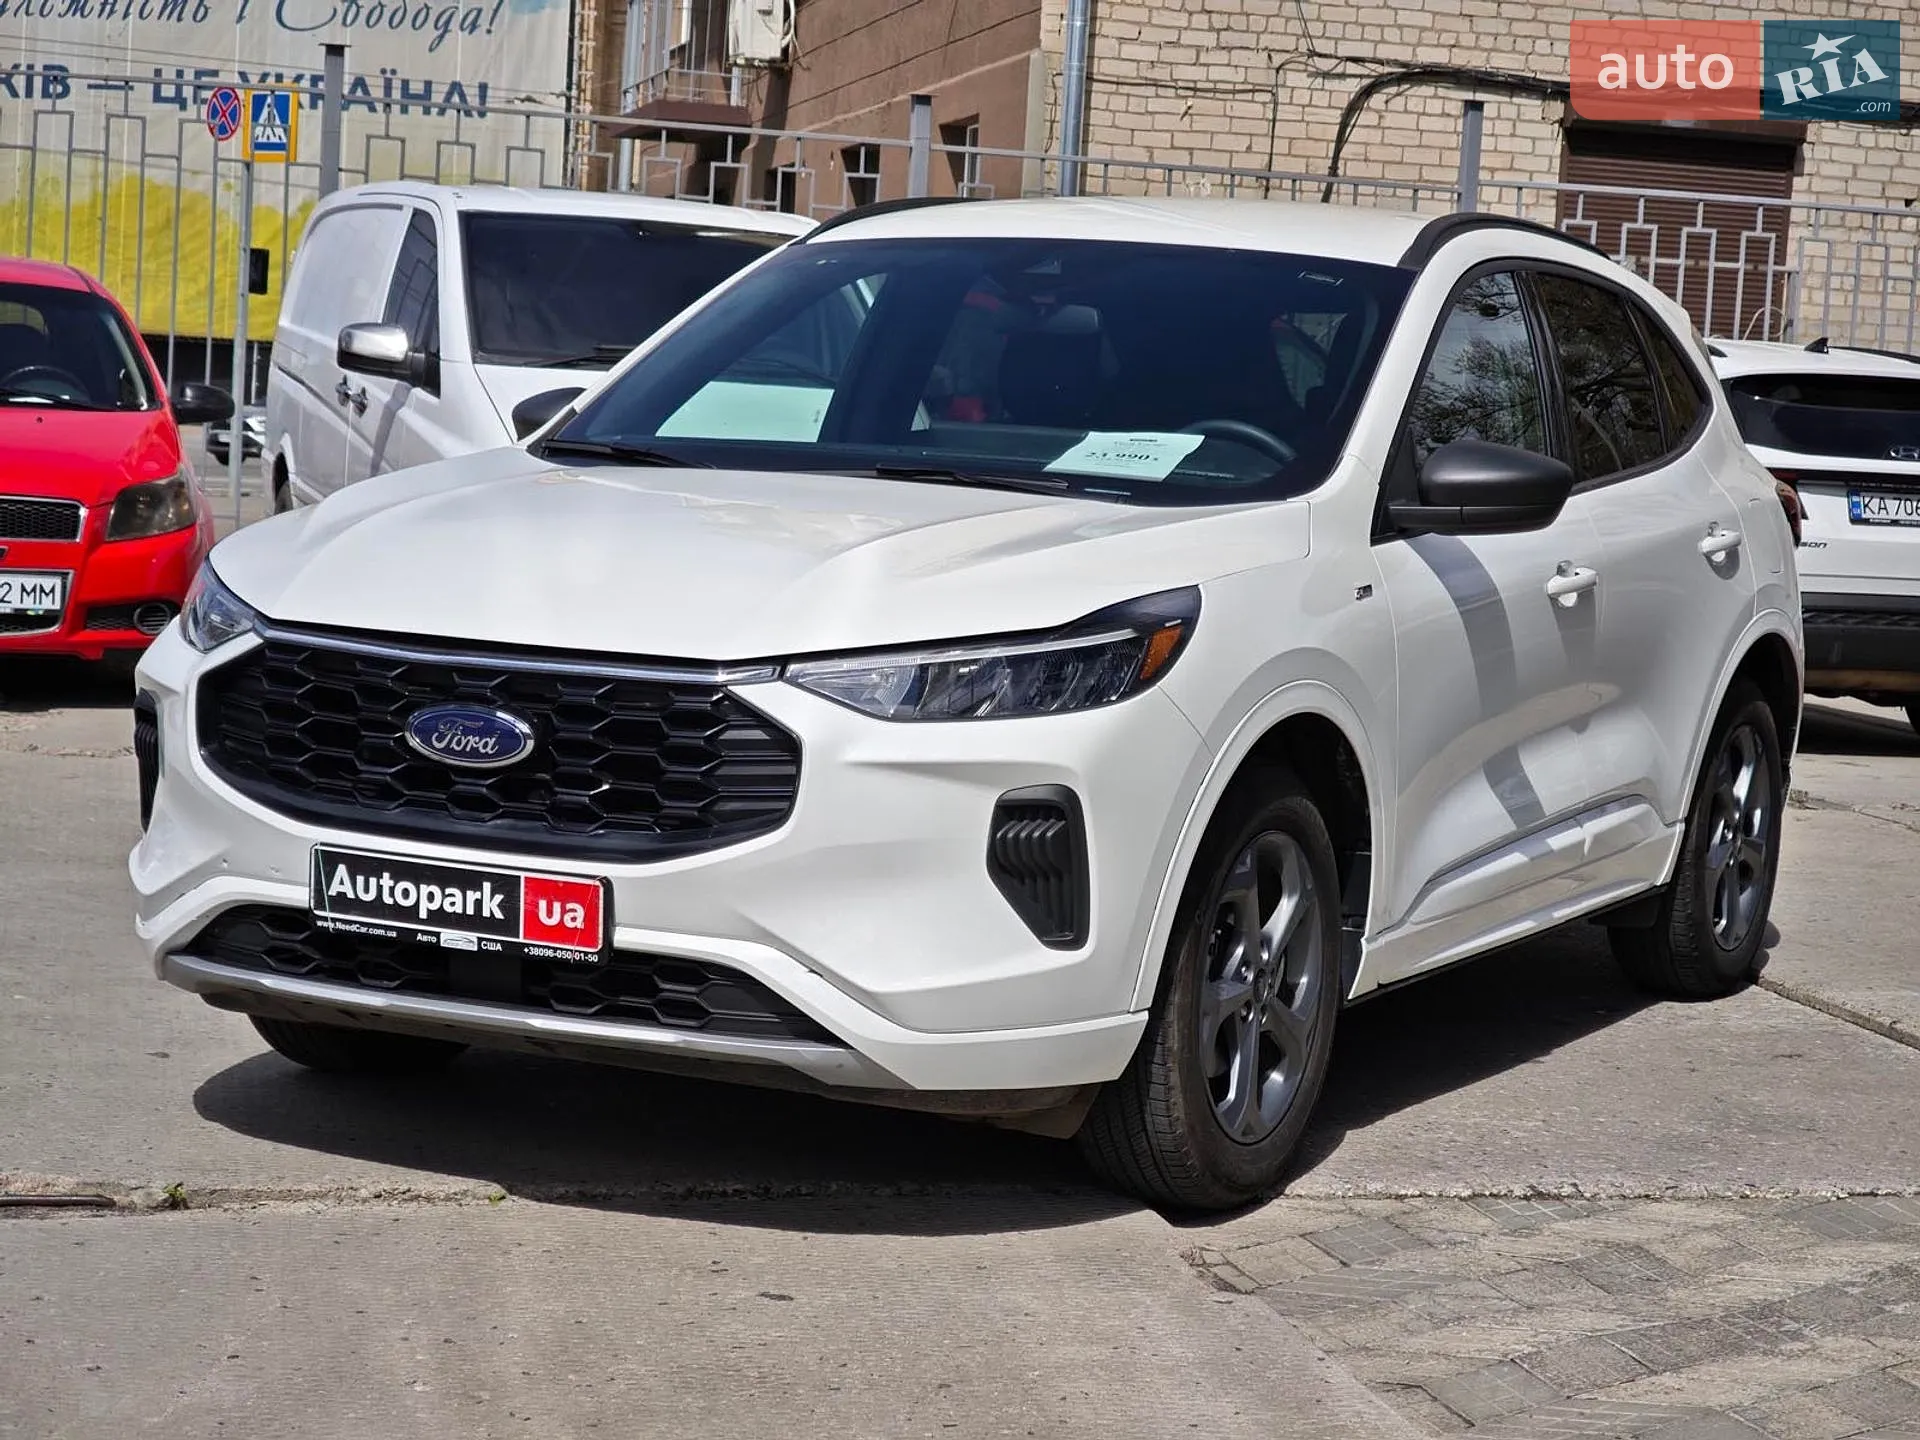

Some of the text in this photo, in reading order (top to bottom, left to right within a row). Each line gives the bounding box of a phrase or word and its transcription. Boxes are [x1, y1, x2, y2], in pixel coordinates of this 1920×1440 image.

[275, 0, 500, 52] Свобода!
[1862, 495, 1889, 515] KA
[20, 582, 56, 606] MM
[431, 716, 501, 755] Ford
[328, 863, 585, 929] Autopark ua
[316, 920, 398, 938] www.NeedCar.com.ua
[416, 932, 437, 943] Авто
[481, 940, 502, 951] США
[523, 946, 599, 963] +38096-050-01-50
